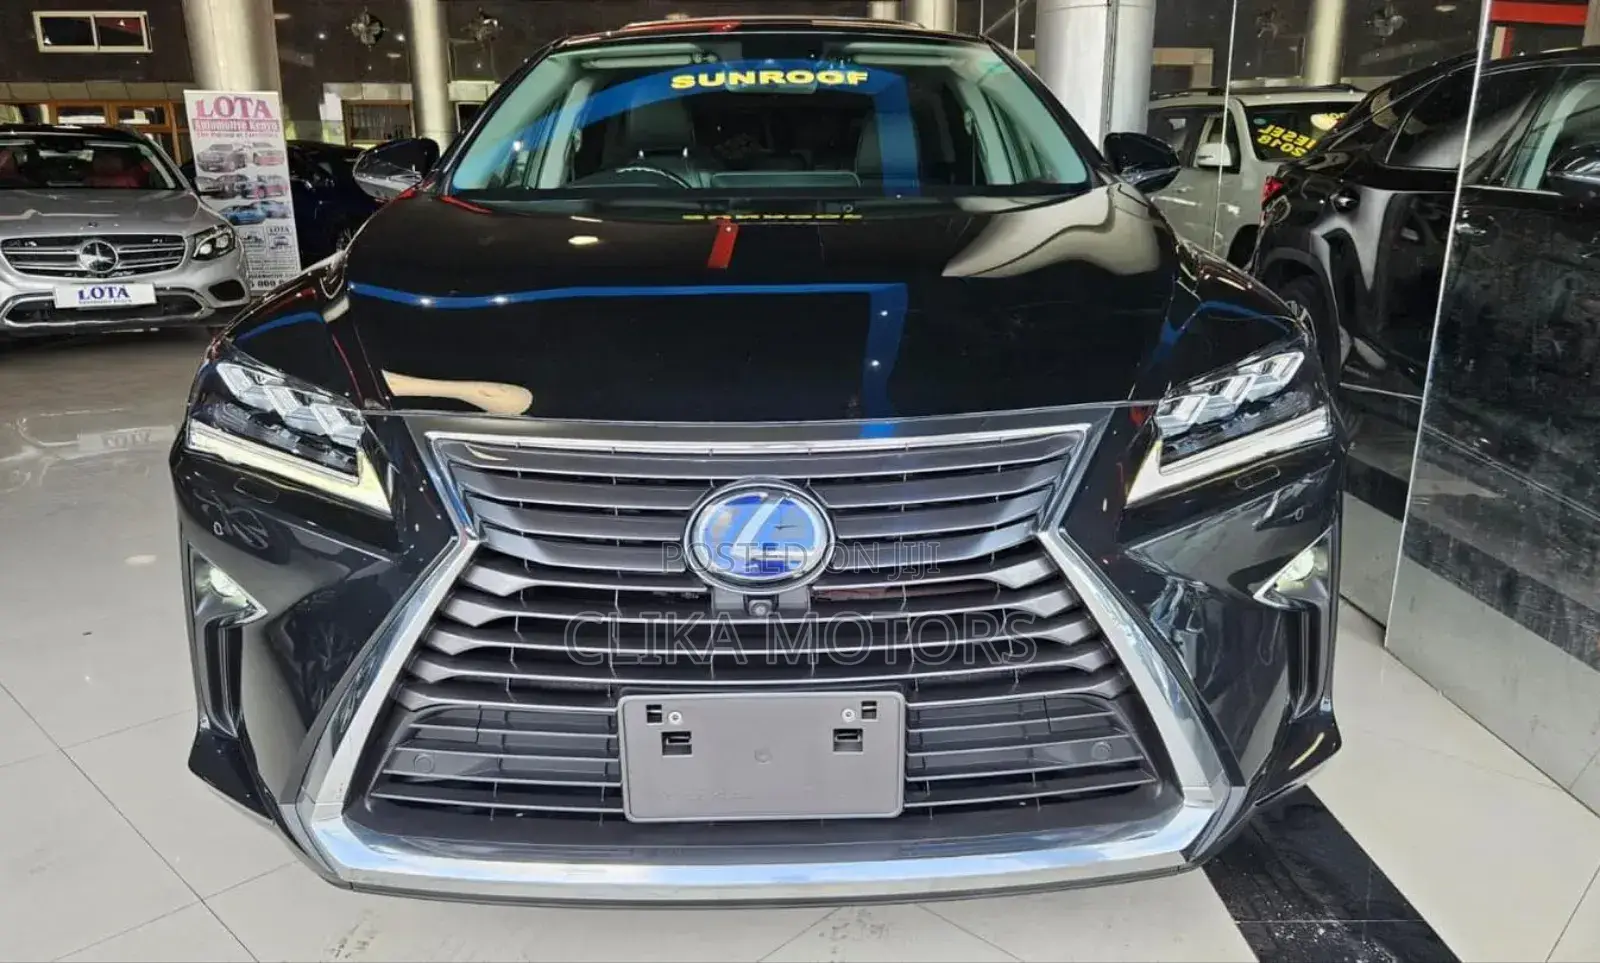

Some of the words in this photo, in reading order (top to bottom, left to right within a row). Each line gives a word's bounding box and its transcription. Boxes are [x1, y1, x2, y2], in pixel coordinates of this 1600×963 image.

[671, 70, 868, 89] SUNROOF
[195, 96, 274, 119] LOTA
[78, 286, 130, 301] LOTA
